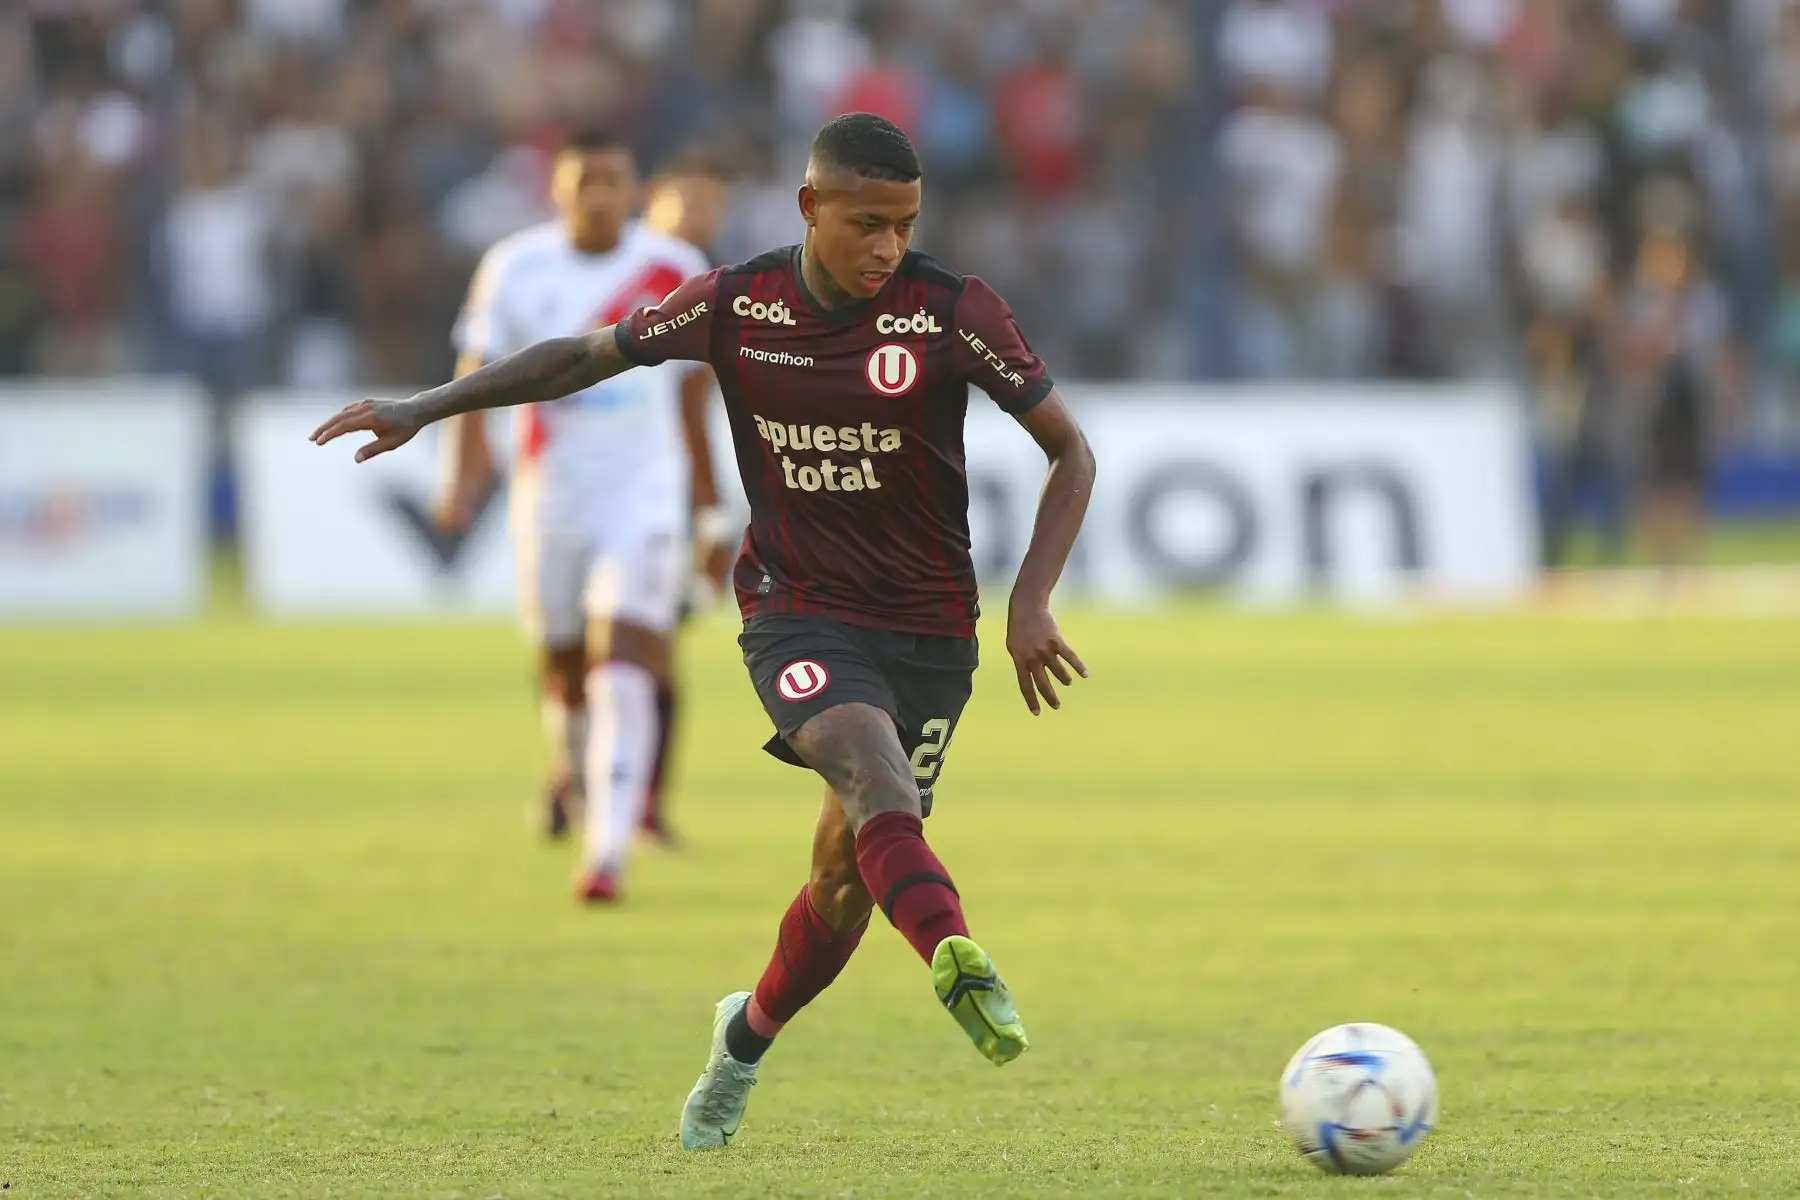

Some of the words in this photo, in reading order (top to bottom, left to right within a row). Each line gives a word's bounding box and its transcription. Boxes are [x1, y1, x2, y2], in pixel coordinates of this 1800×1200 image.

[639, 301, 709, 340] JETOUR
[739, 345, 814, 367] marathon
[878, 352, 907, 390] U
[752, 414, 902, 453] apuesta
[781, 455, 882, 492] total
